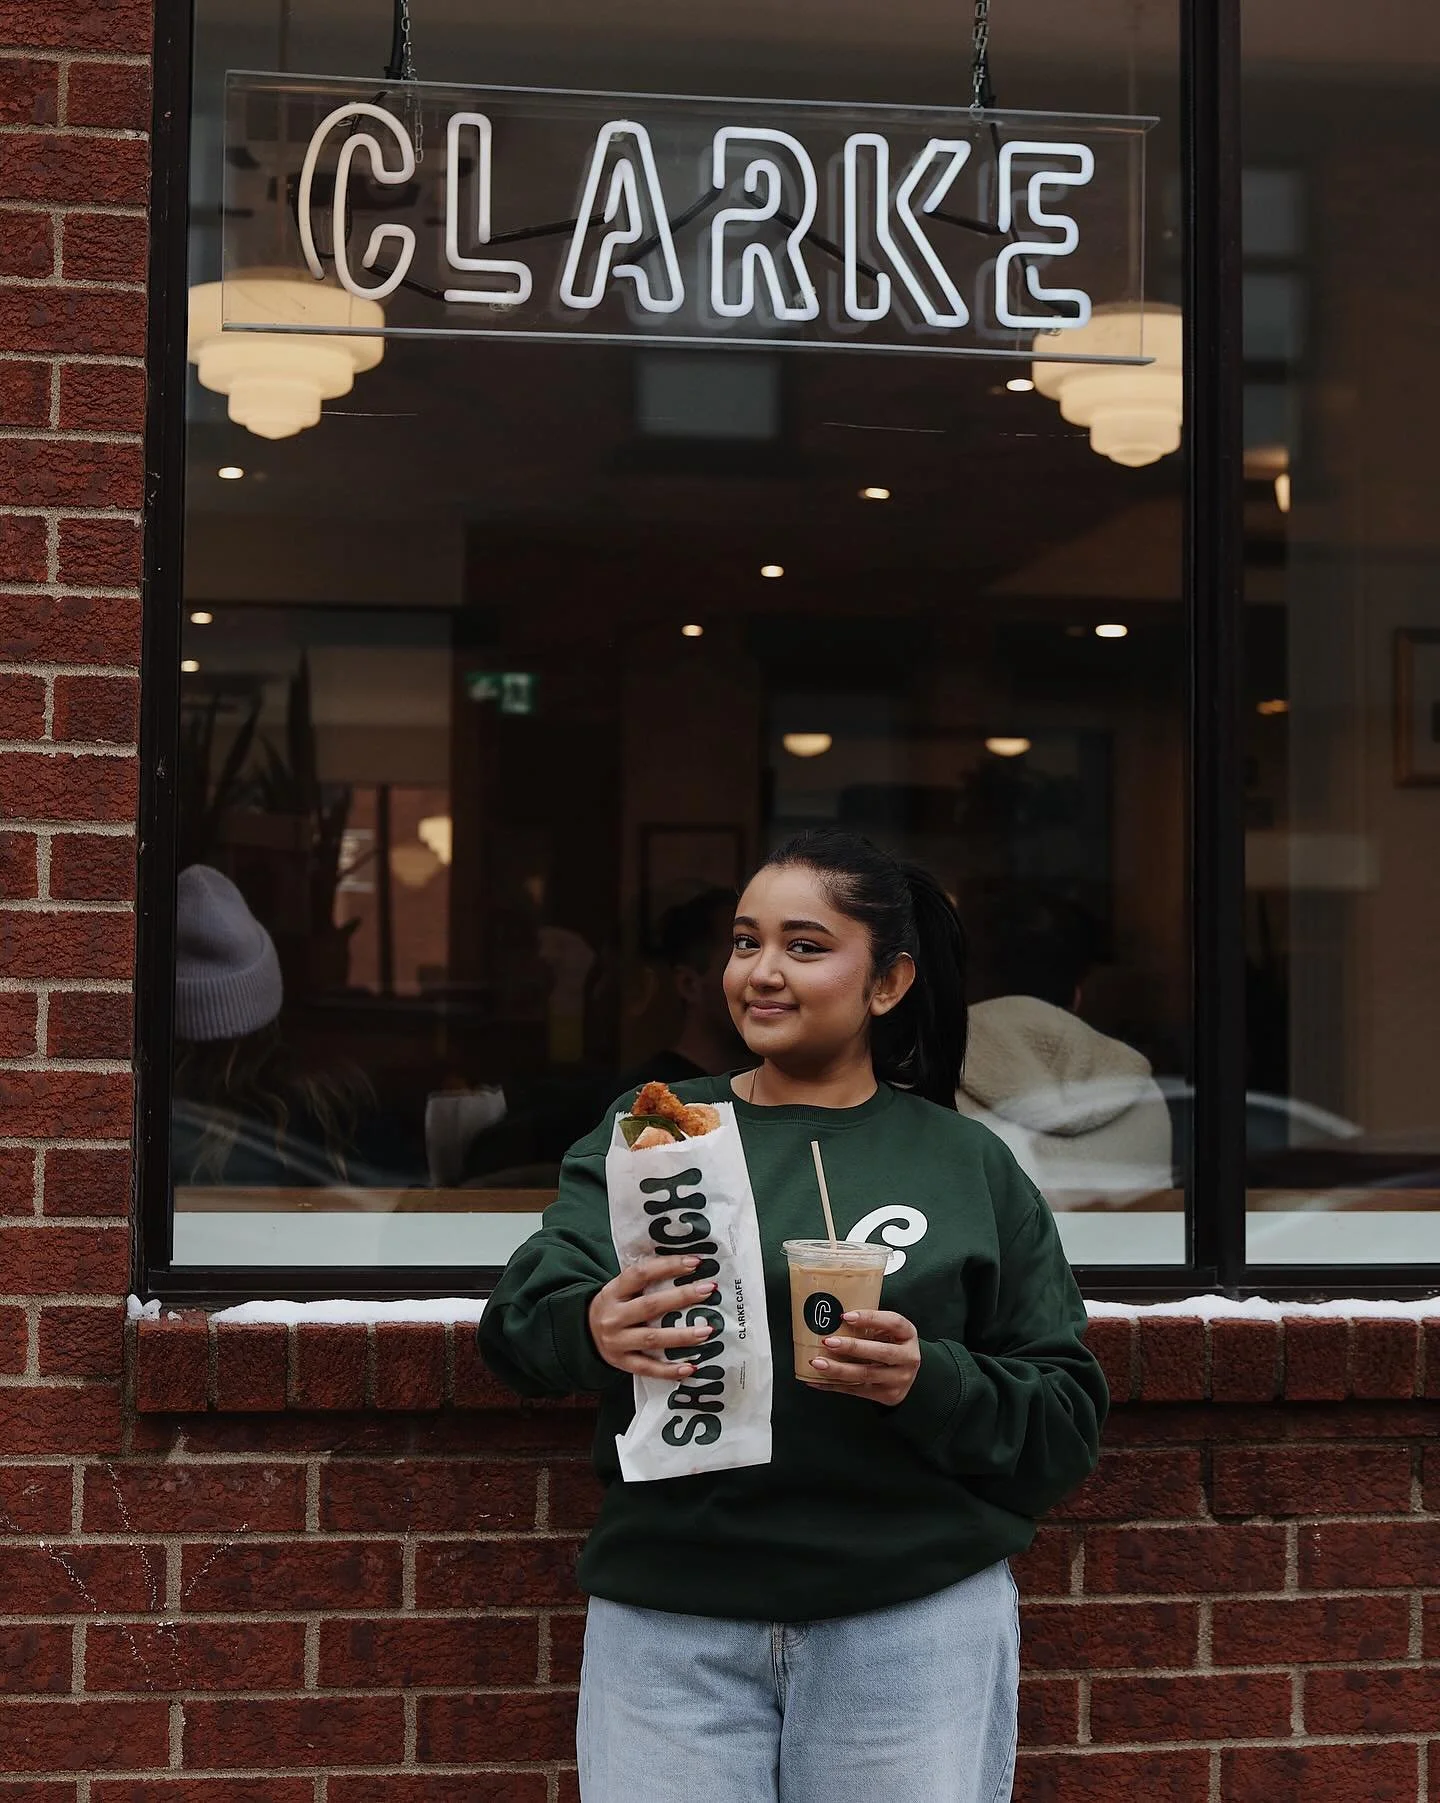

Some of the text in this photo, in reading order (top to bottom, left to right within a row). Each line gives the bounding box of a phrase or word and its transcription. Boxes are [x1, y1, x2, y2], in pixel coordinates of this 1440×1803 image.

[299, 104, 1094, 330] CLARKE
[734, 1278, 746, 1340] CLARKE CAFE
[814, 1300, 831, 1328] C
